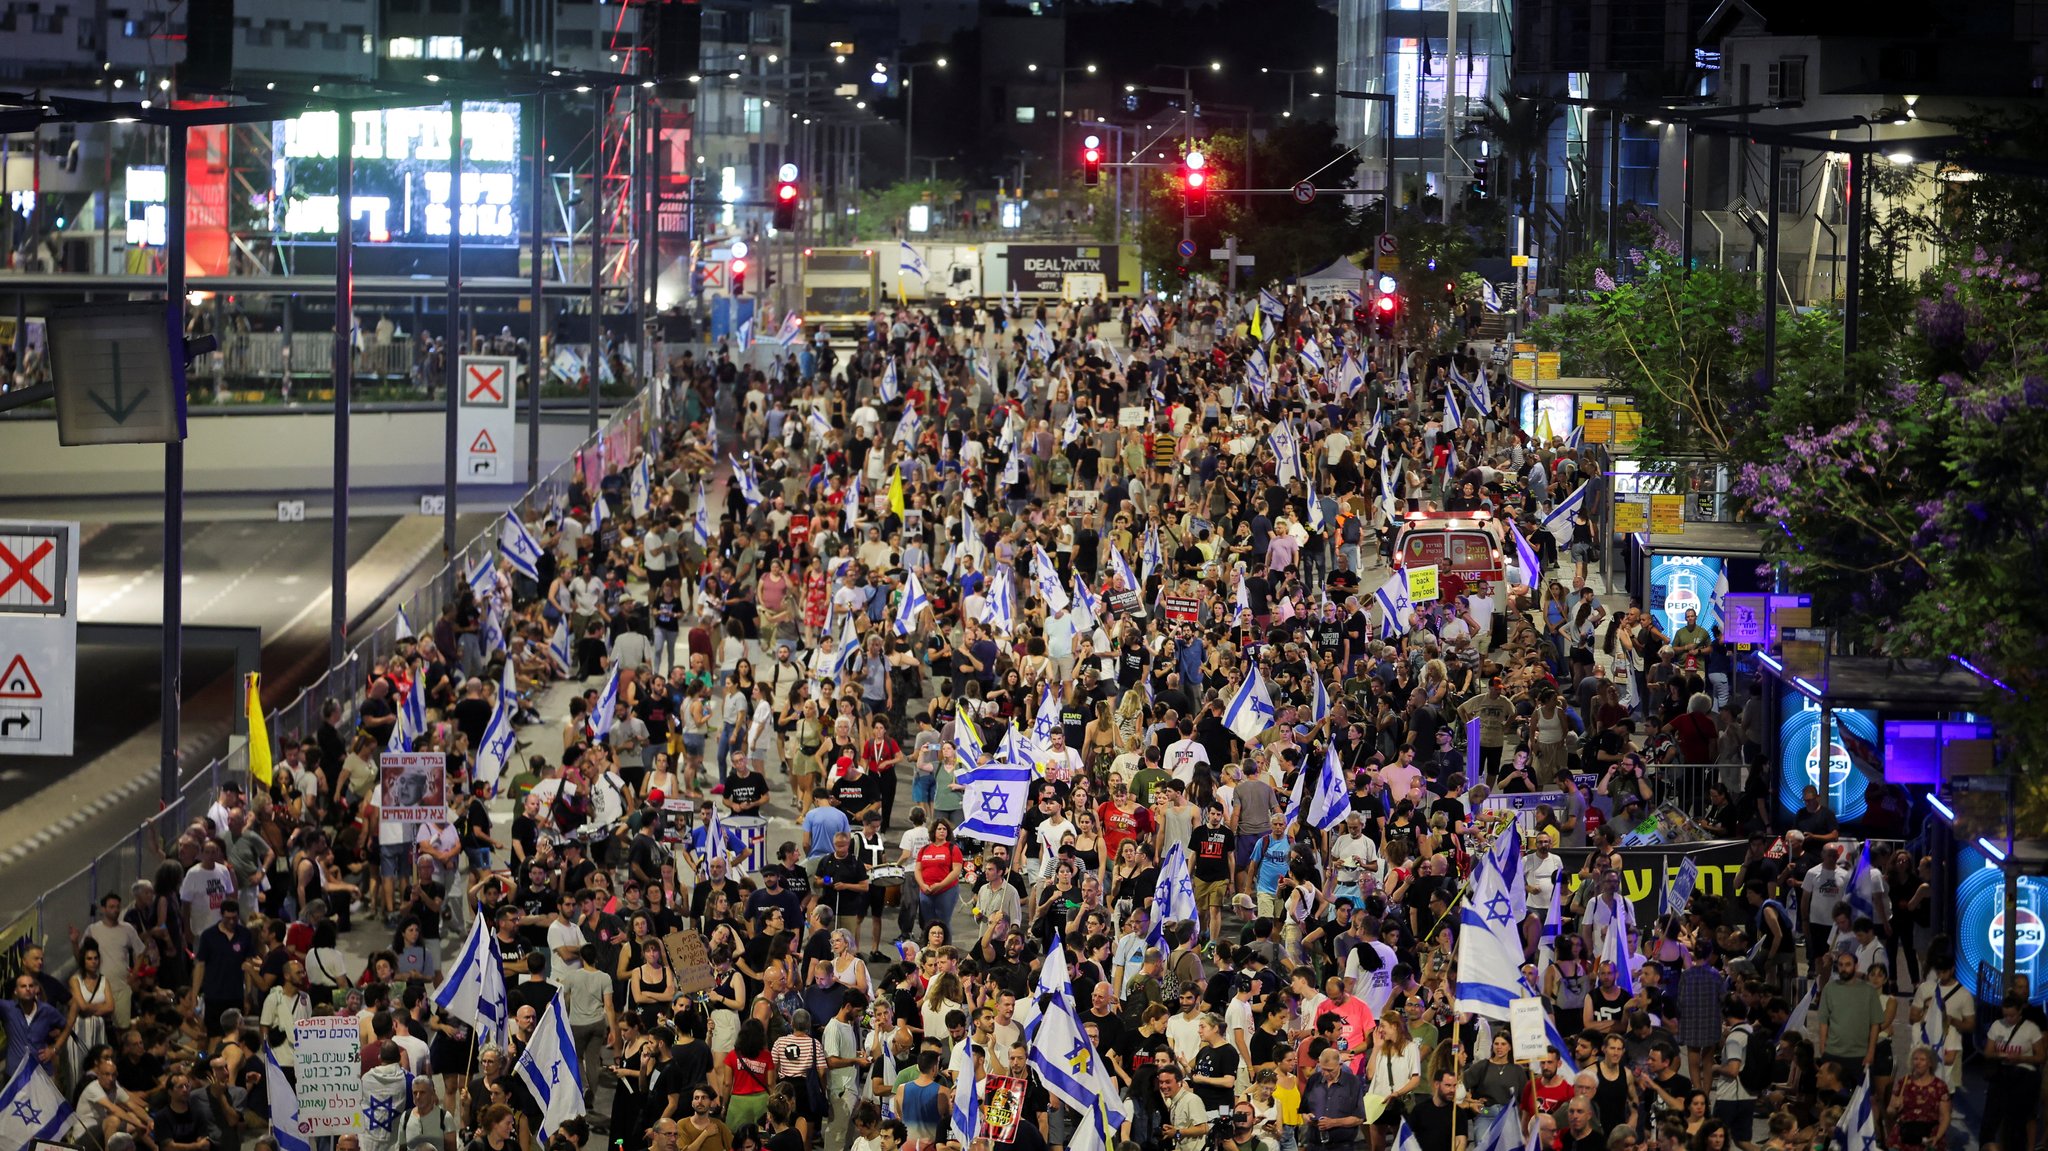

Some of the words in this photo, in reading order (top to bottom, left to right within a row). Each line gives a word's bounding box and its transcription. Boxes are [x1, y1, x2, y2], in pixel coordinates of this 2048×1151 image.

[1024, 259, 1061, 271] IDEAL
[1061, 256, 1100, 271] אידיאל
[1663, 556, 1704, 565] LOOK
[1416, 577, 1429, 585] back
[402, 757, 417, 765] אנחנו
[421, 757, 443, 766] בגללך
[382, 809, 413, 819] מהחיים
[416, 807, 428, 819] לנו
[431, 809, 444, 819] צא
[1993, 929, 2041, 940] PPSI
[501, 952, 519, 960] RAW
[329, 1028, 358, 1039] הסכם
[322, 1053, 346, 1062] שנים
[322, 1083, 359, 1092] שחררו
[329, 1094, 356, 1108] כולם
